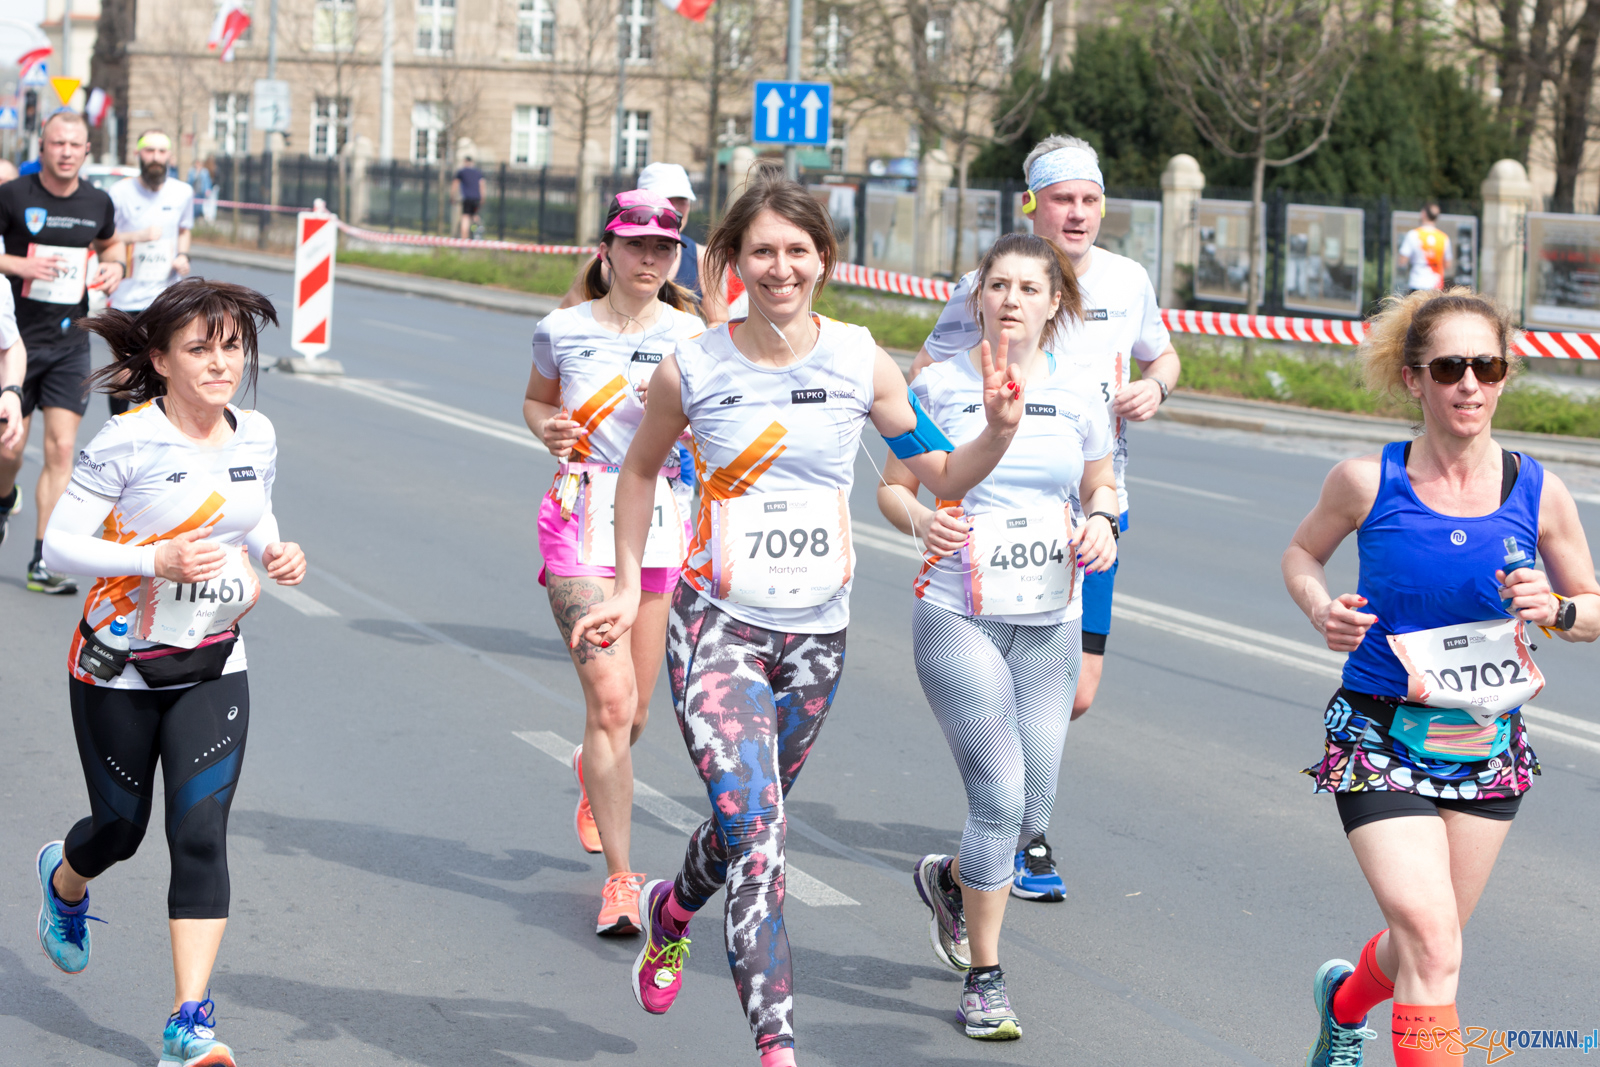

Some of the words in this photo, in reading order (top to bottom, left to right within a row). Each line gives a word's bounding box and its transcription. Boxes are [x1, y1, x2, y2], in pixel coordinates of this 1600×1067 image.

[720, 395, 743, 405] 4F
[806, 391, 824, 400] PKO
[962, 403, 982, 414] 4F
[1038, 406, 1054, 414] PKO
[166, 471, 188, 483] 4F
[241, 470, 254, 478] PKO
[745, 528, 830, 559] 7098
[990, 539, 1064, 570] 4804
[768, 566, 808, 575] Martyna
[1020, 574, 1043, 582] Kasia
[175, 578, 244, 603] 11461
[1454, 638, 1467, 646] PKO
[1425, 660, 1528, 692] 10702
[1471, 694, 1499, 706] Agata
